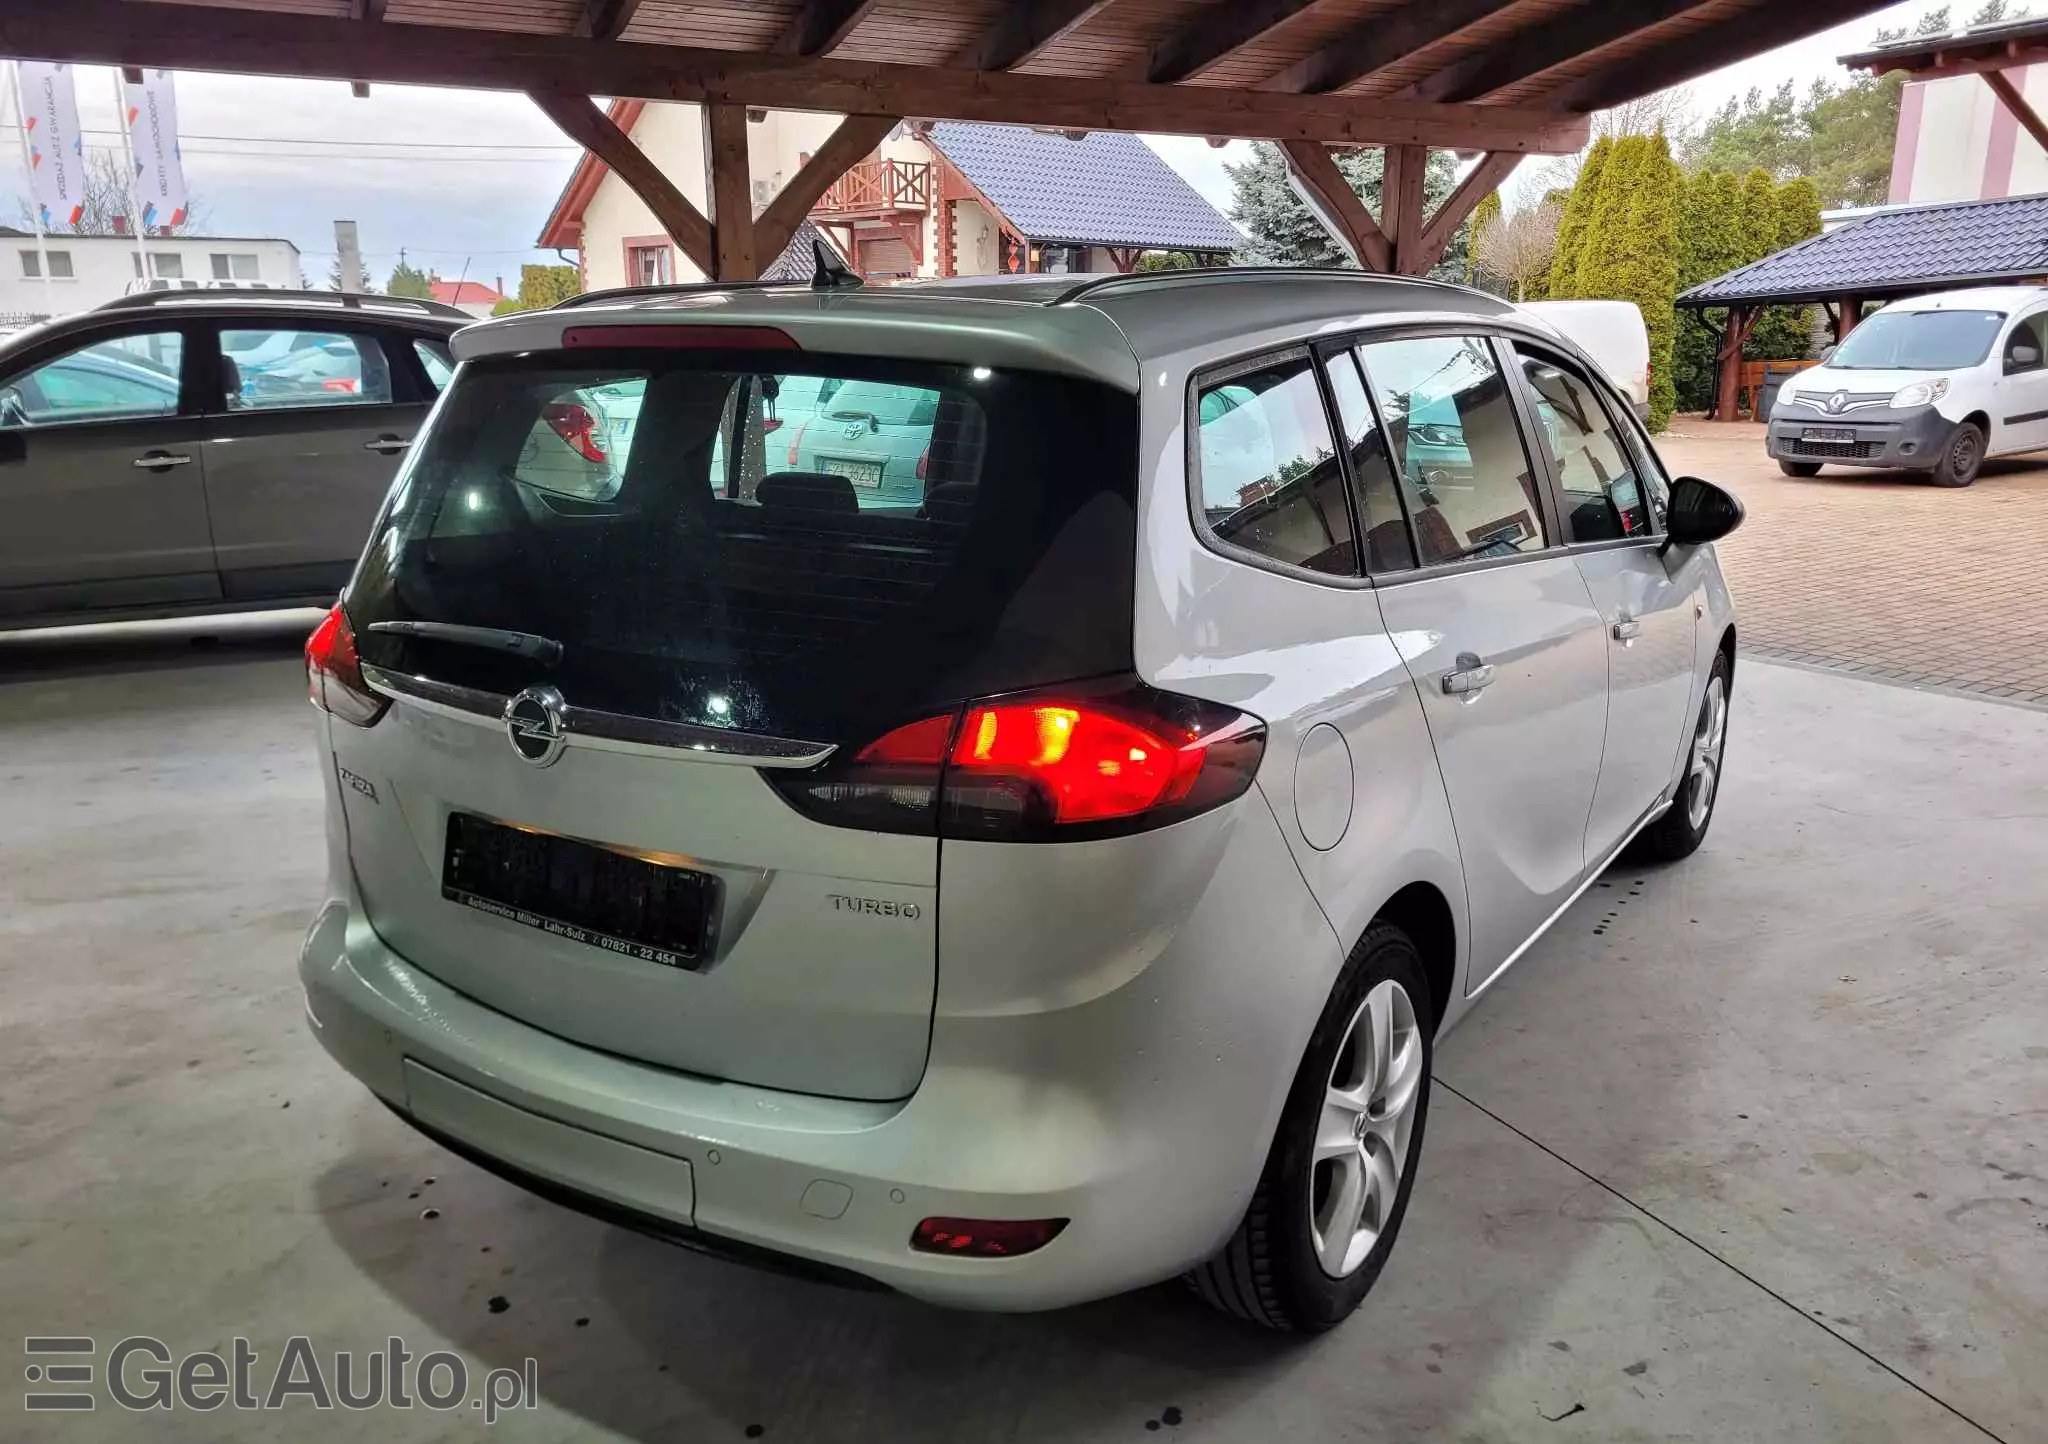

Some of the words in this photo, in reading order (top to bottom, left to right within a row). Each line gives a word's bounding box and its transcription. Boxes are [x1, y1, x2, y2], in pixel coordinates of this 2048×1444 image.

[826, 894, 921, 920] TURBO
[544, 920, 586, 941] Lahr-Sulz
[601, 937, 631, 953] 07821
[640, 947, 653, 960] 22
[655, 952, 677, 965] 454
